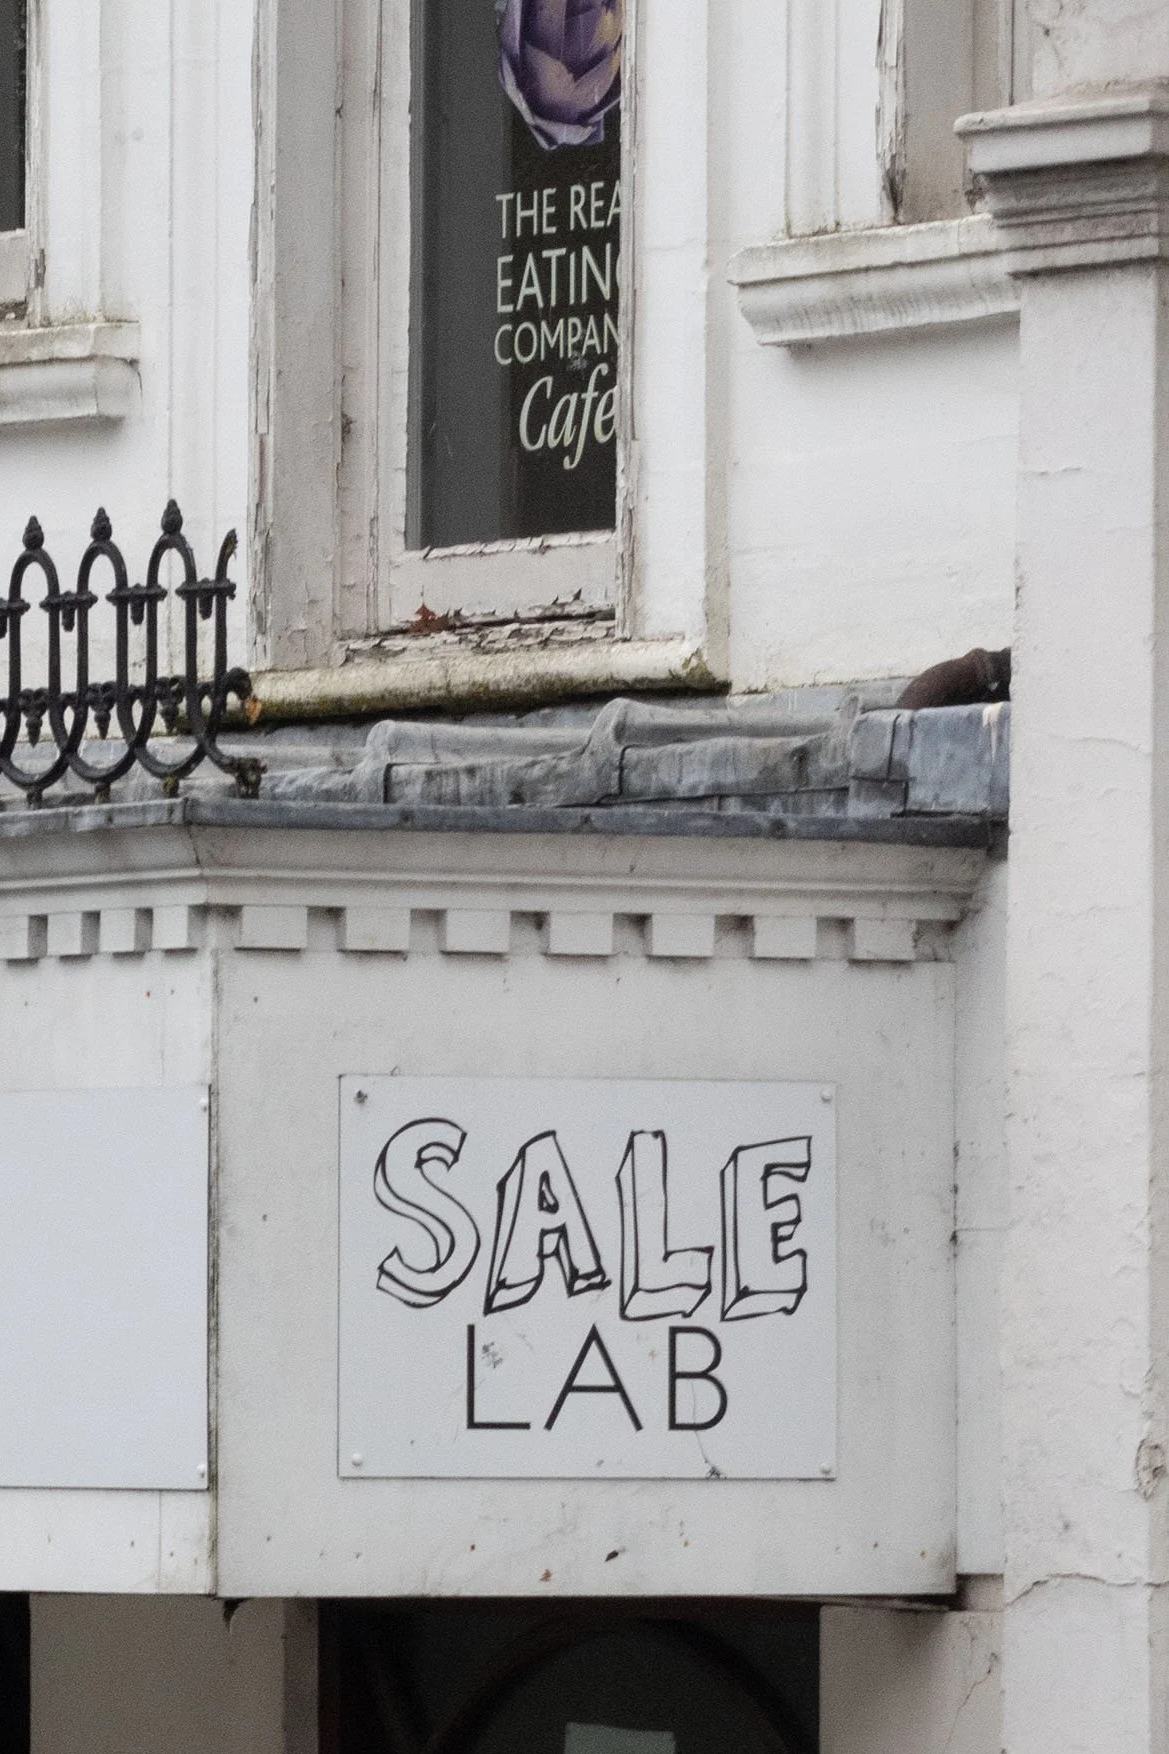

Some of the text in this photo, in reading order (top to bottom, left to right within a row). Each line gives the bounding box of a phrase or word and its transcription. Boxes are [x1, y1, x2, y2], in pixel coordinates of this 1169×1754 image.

[495, 187, 557, 239] THE
[496, 242, 620, 313] EATIN
[373, 1117, 813, 1322] SALE
[467, 1322, 728, 1432] LAB
